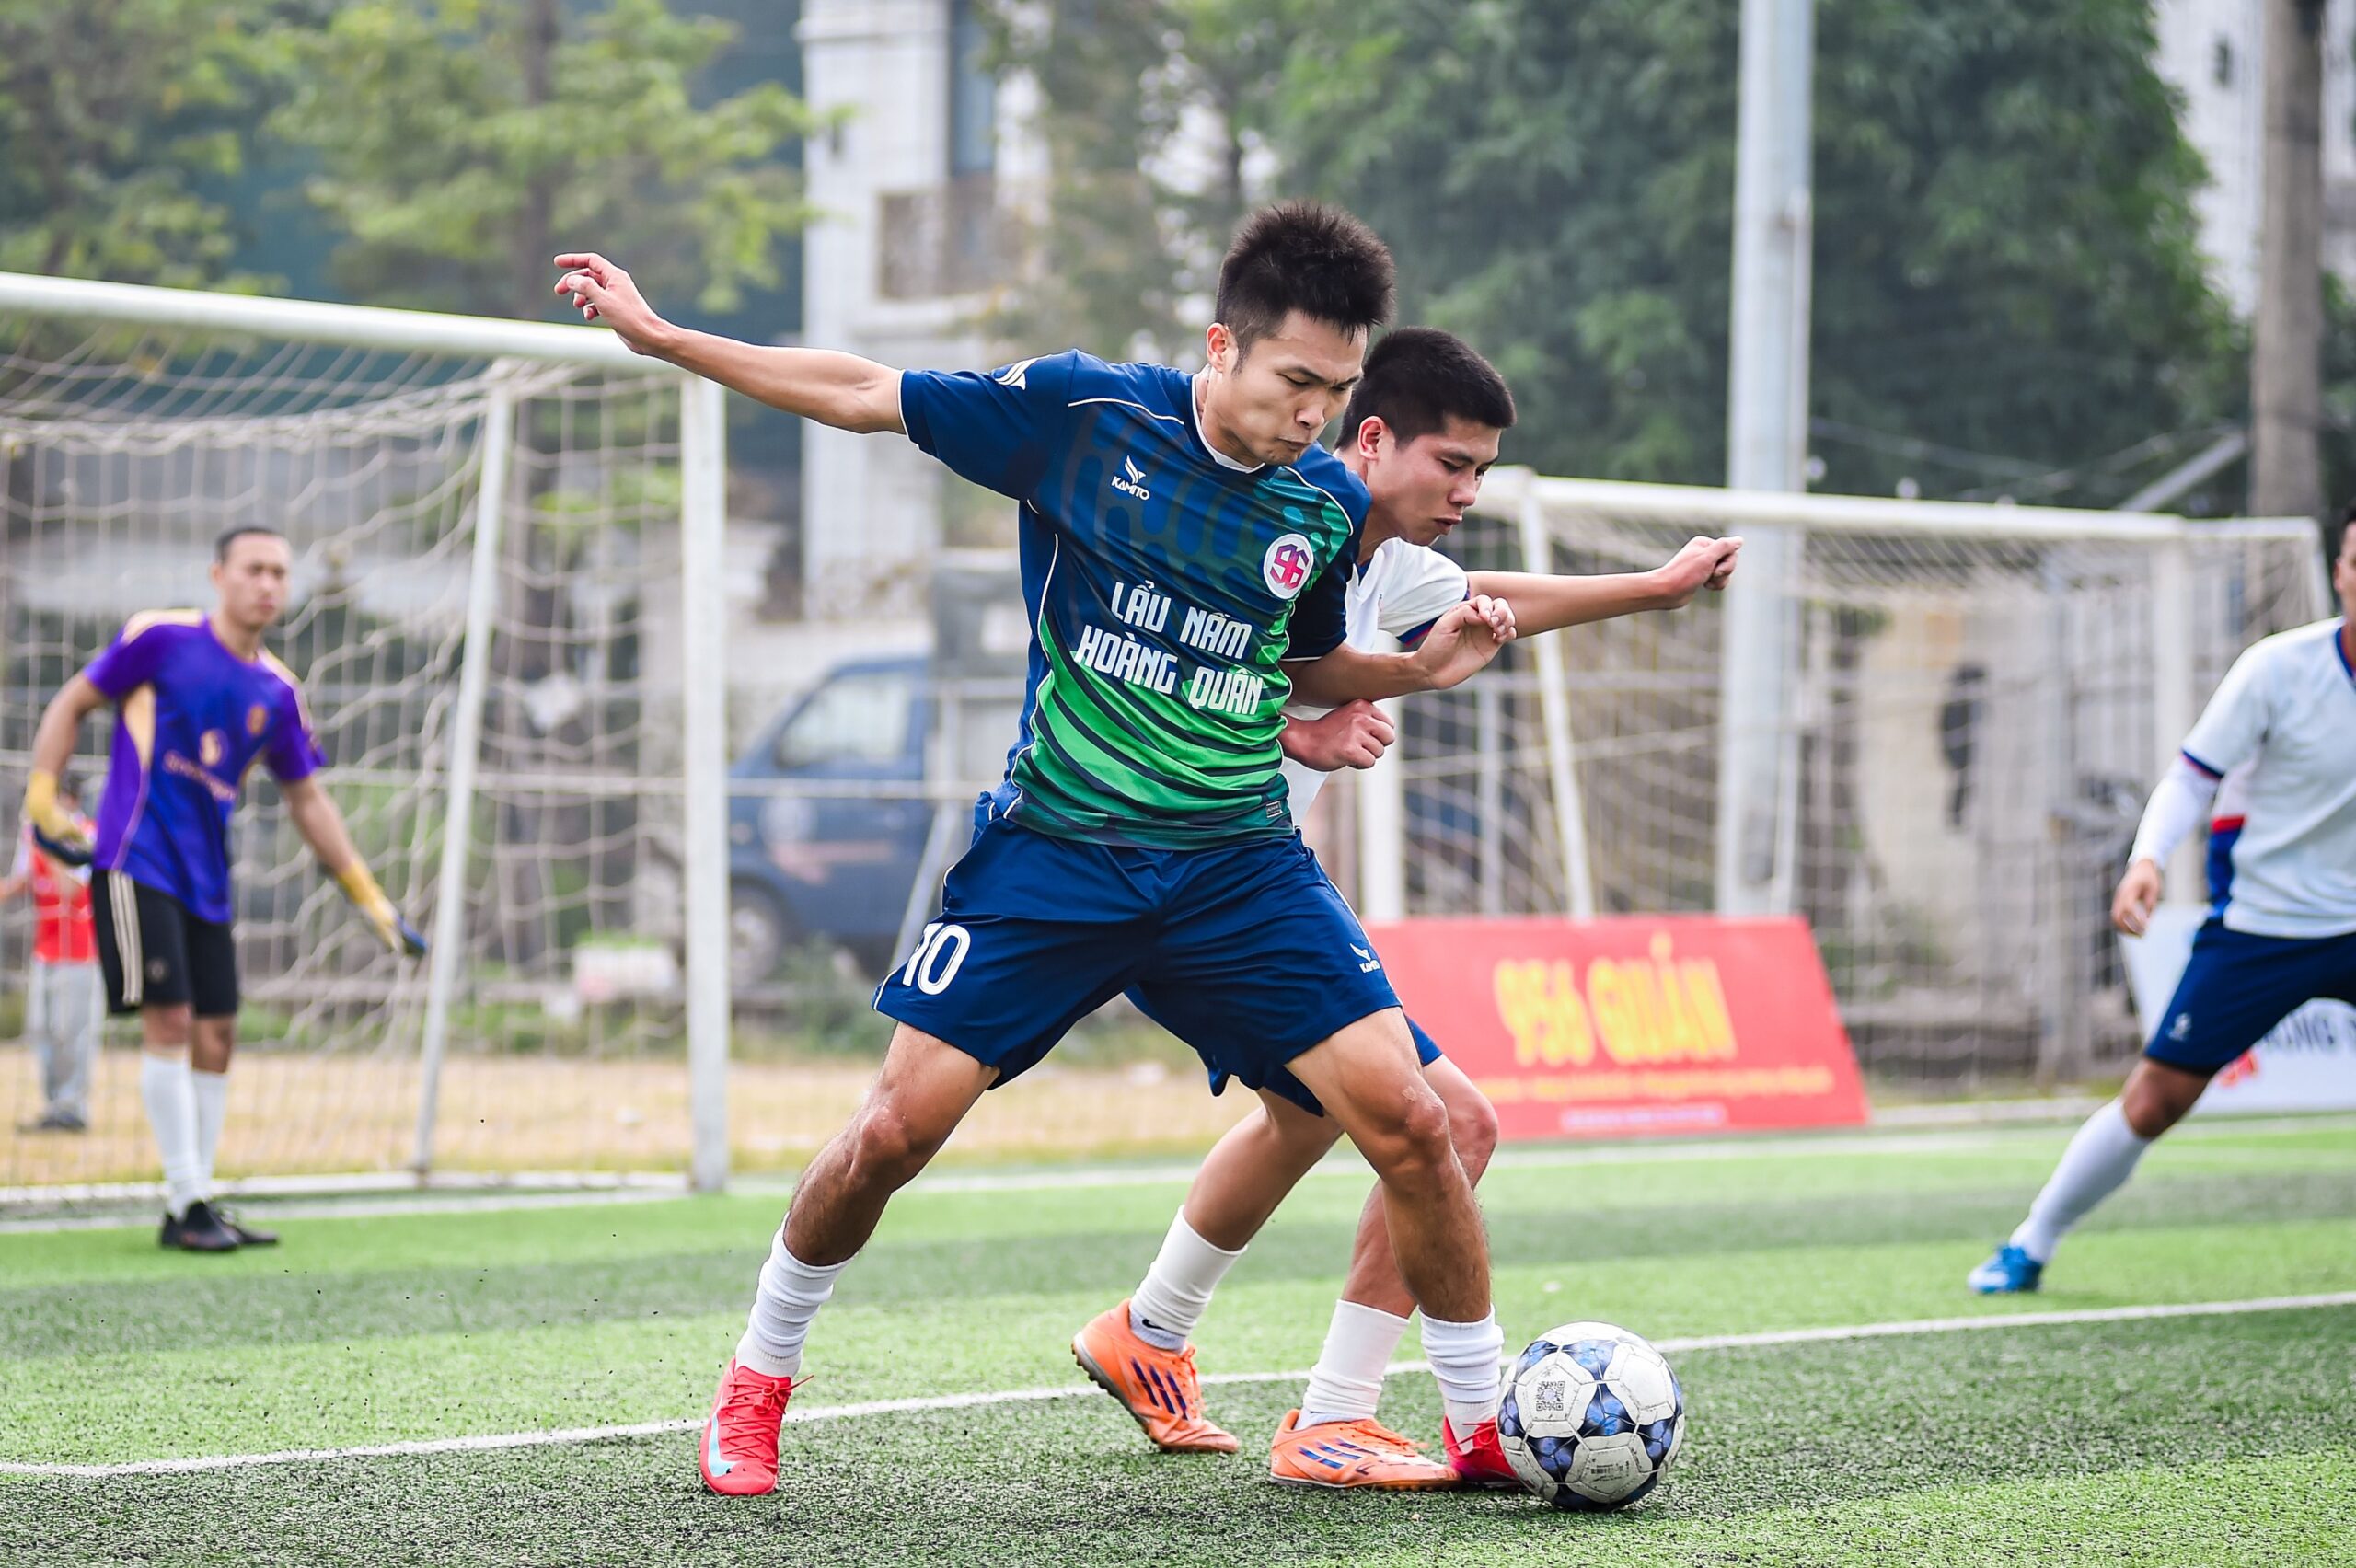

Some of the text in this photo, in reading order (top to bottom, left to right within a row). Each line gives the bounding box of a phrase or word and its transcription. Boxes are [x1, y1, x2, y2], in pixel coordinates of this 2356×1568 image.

[1111, 475, 1150, 501] KAMITO
[1110, 579, 1172, 633] LẨU
[1073, 624, 1264, 715] HOÀNG QUÂN
[902, 922, 971, 996] 10
